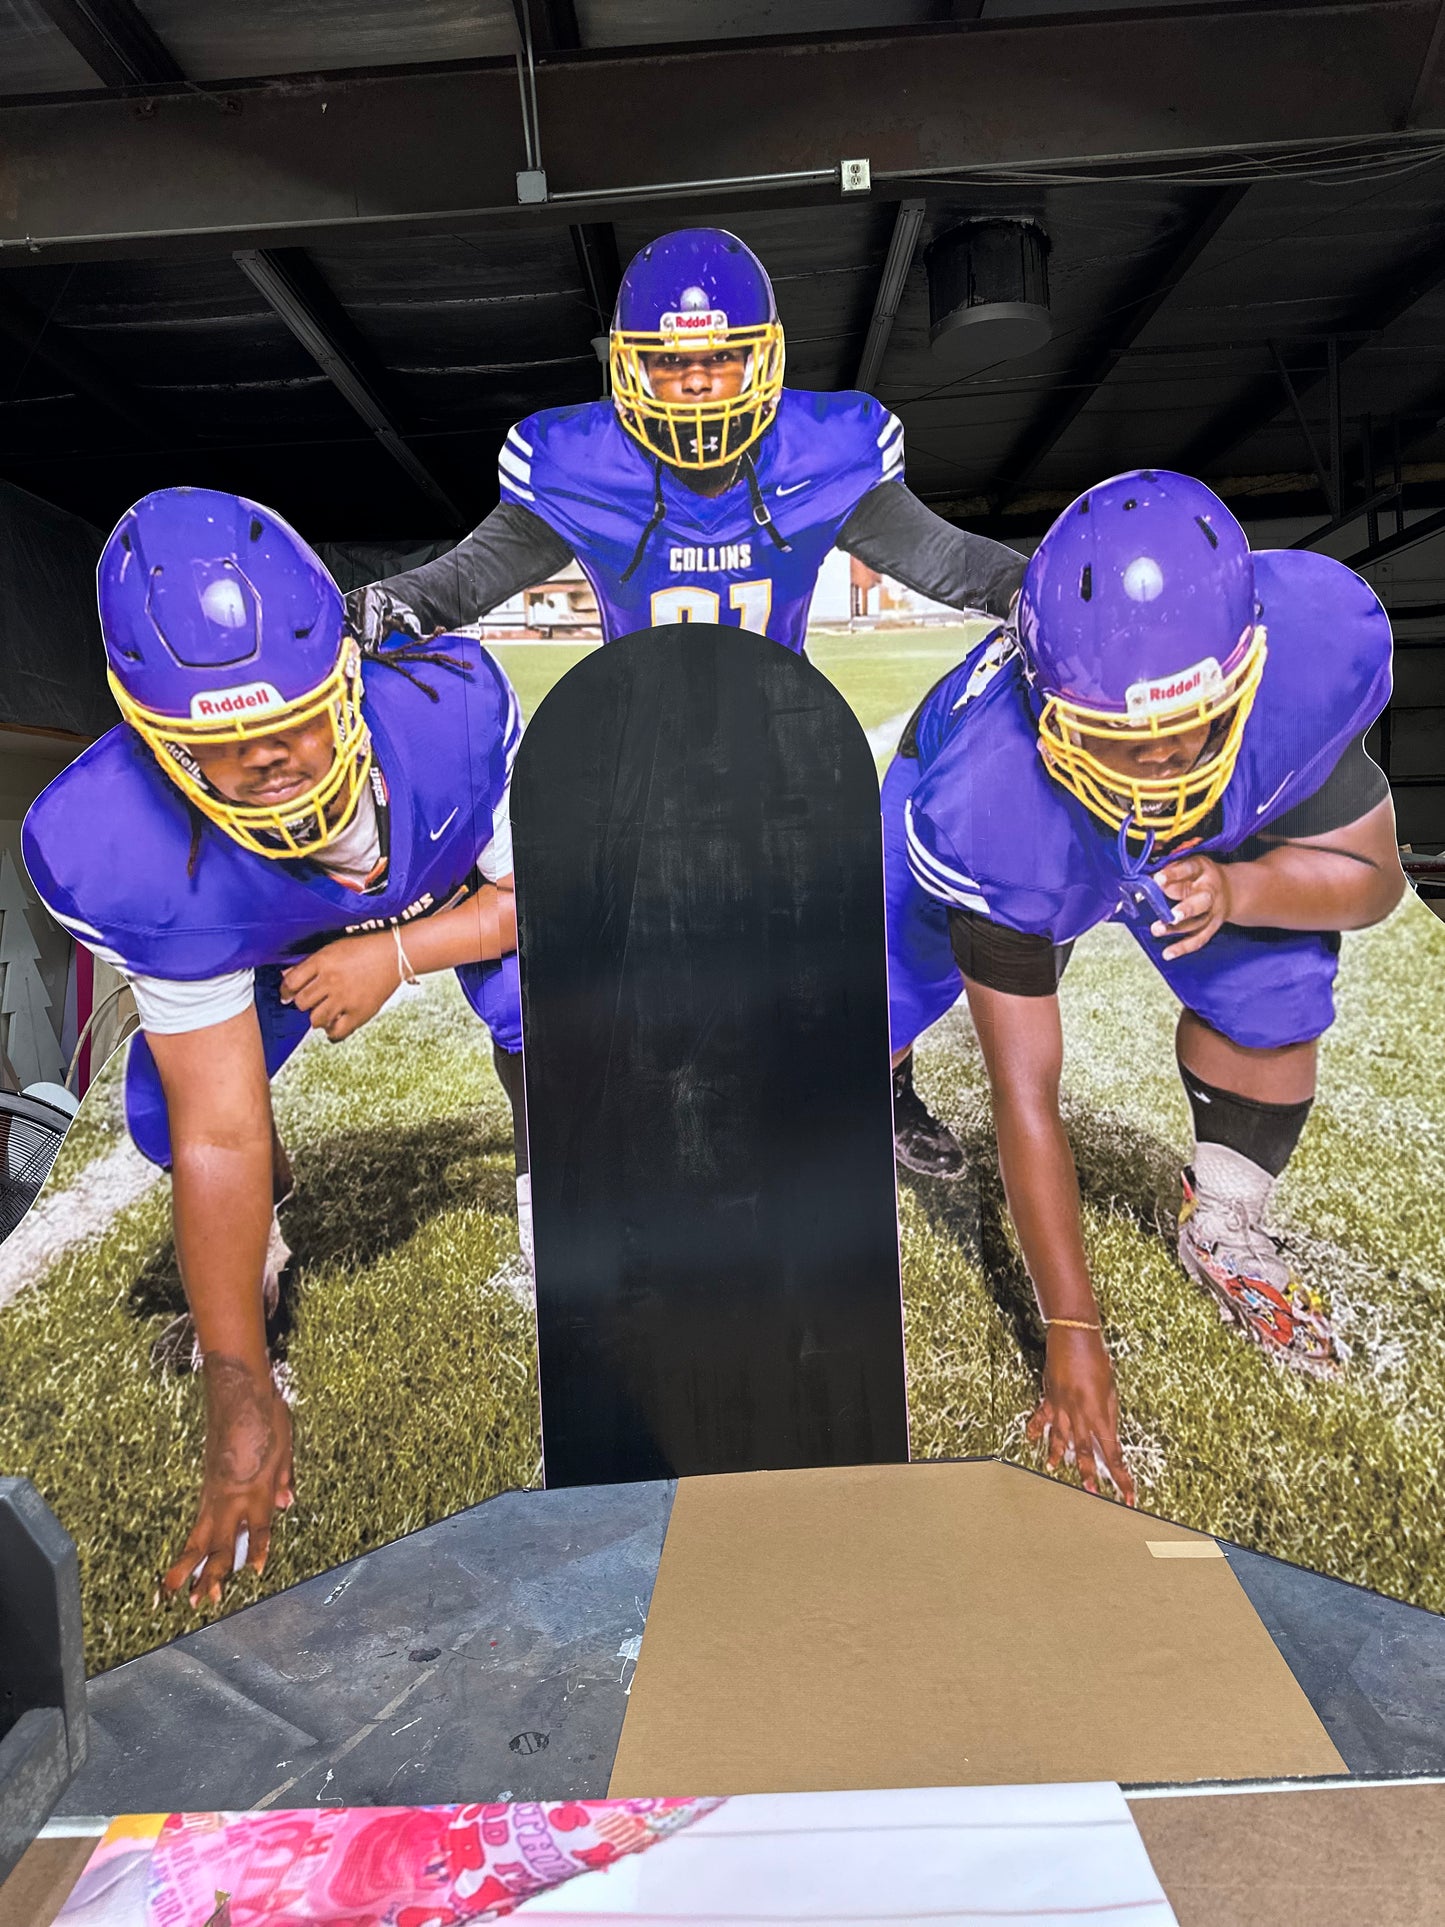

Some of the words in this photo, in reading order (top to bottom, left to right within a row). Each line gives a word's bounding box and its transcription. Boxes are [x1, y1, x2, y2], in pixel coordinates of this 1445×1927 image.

[675, 314, 712, 329] Riddell
[669, 544, 751, 573] COLLINS
[1149, 671, 1201, 701] Riddell
[198, 689, 270, 715] Riddell
[160, 738, 202, 779] ddell
